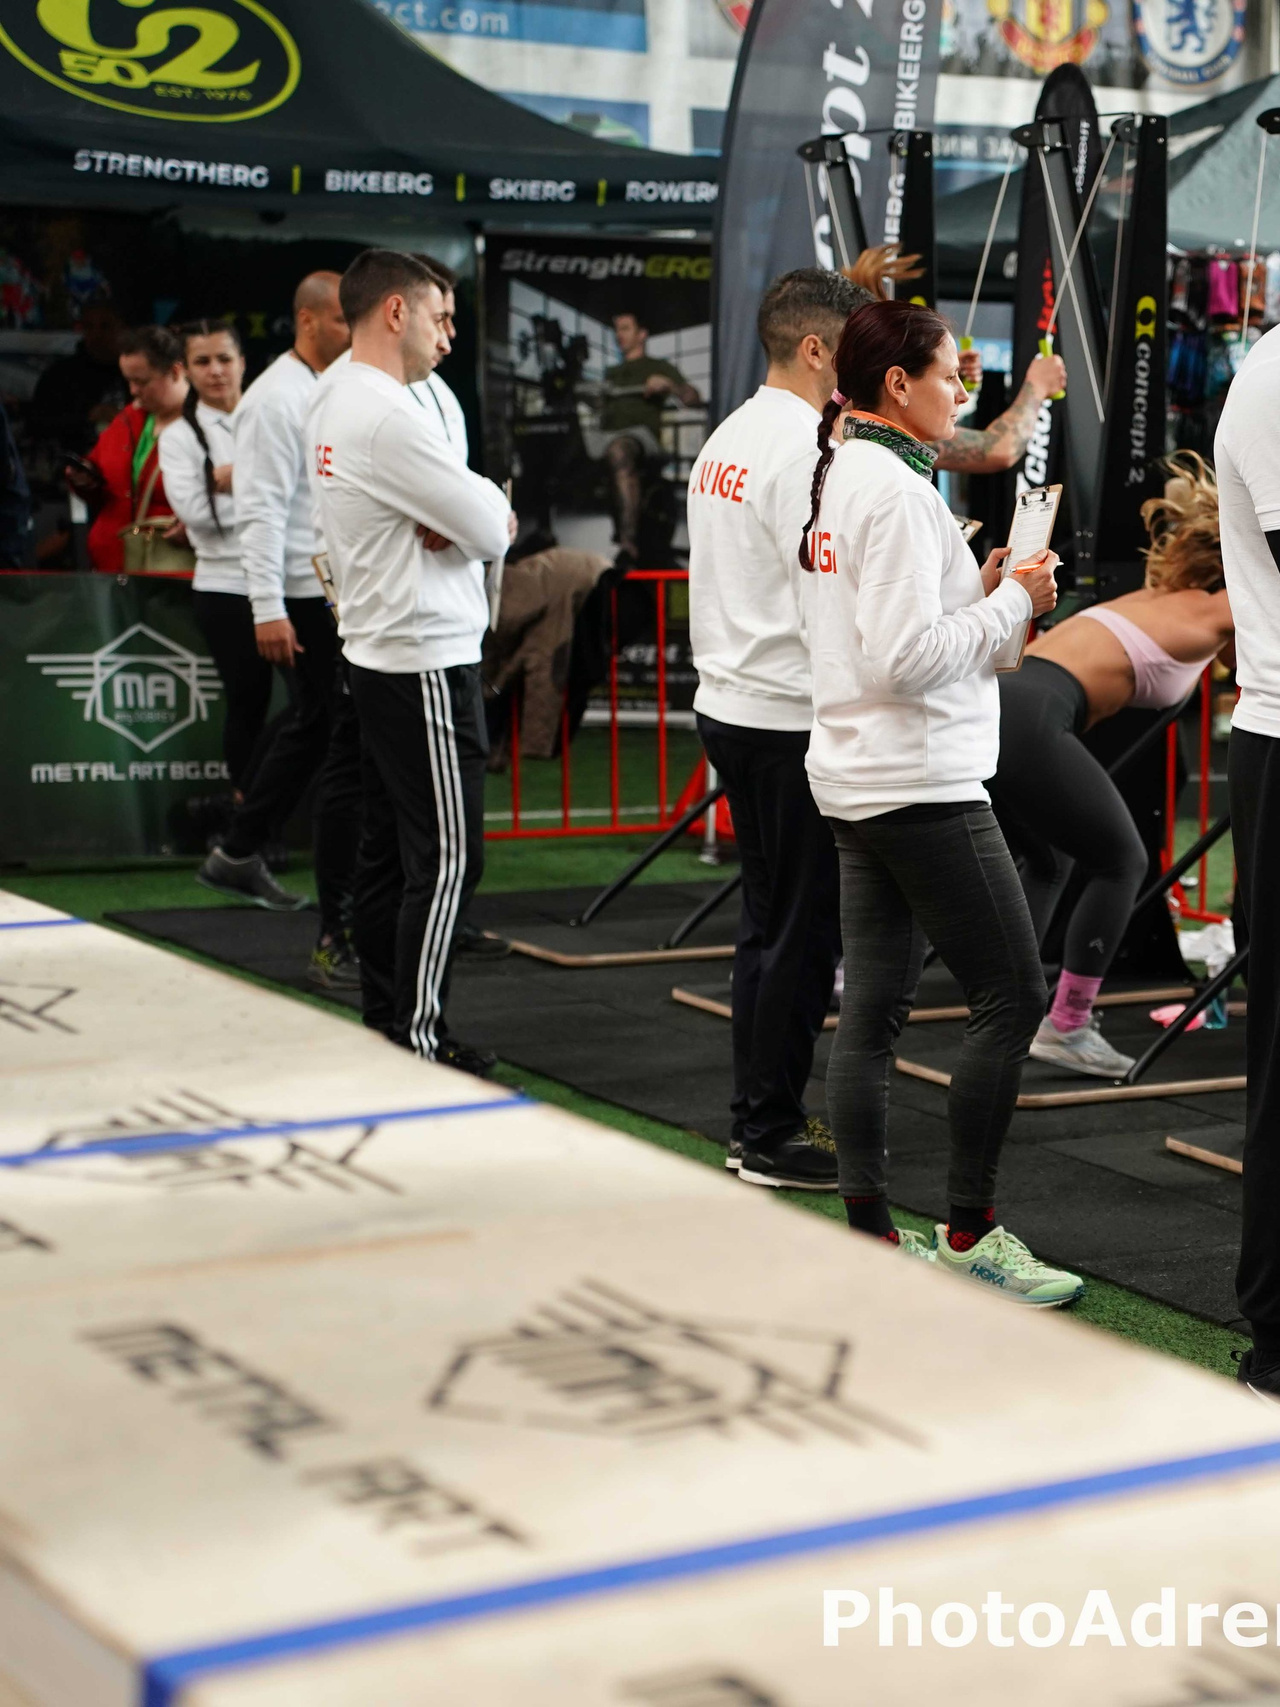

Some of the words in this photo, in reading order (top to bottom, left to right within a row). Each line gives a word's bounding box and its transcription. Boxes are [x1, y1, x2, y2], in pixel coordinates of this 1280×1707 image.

[73, 149, 270, 188] STRENGTHERG
[325, 169, 434, 196] BIKEERG
[489, 178, 577, 201] SKIERG
[501, 249, 712, 280] StrengthERG
[1130, 341, 1152, 459] concept
[1128, 466, 1145, 484] 2
[970, 1263, 1006, 1287] HOKA
